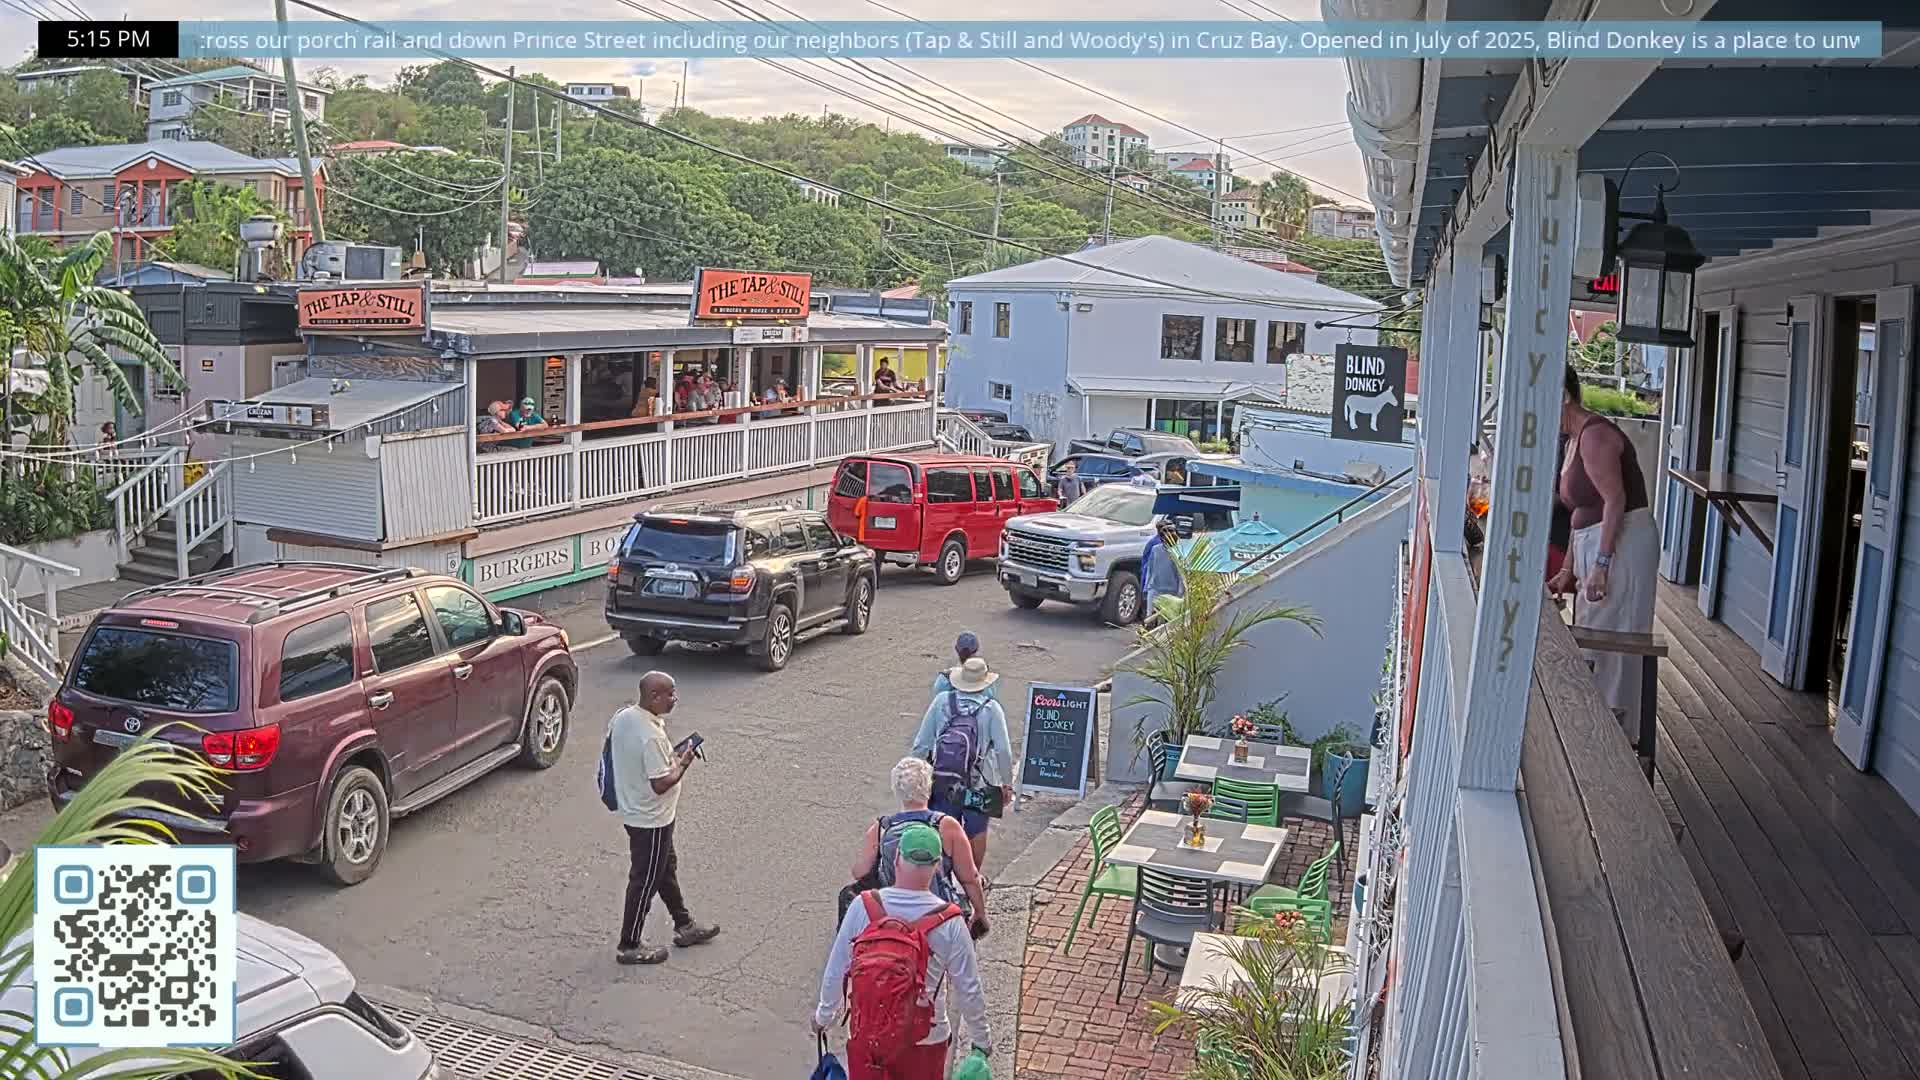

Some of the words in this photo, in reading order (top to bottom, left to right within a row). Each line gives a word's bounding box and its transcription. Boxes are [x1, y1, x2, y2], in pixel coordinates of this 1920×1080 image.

[1528, 165, 1563, 387] Juicy
[708, 280, 738, 304] THE
[740, 276, 767, 294] TAP
[764, 276, 778, 295] &
[779, 280, 805, 307] STILL
[304, 296, 331, 317] THE
[331, 292, 360, 308] TAP
[358, 291, 376, 308] &
[376, 293, 416, 317] STILL
[1346, 355, 1385, 376] BLIND
[1345, 377, 1385, 392] DONKEY
[1497, 411, 1538, 673] Booty?
[480, 548, 569, 582] BURGERS
[1034, 694, 1061, 707] Coors
[1062, 700, 1088, 710] LIGHT
[1035, 708, 1060, 721] BLIND
[1043, 720, 1074, 731] DONKEY
